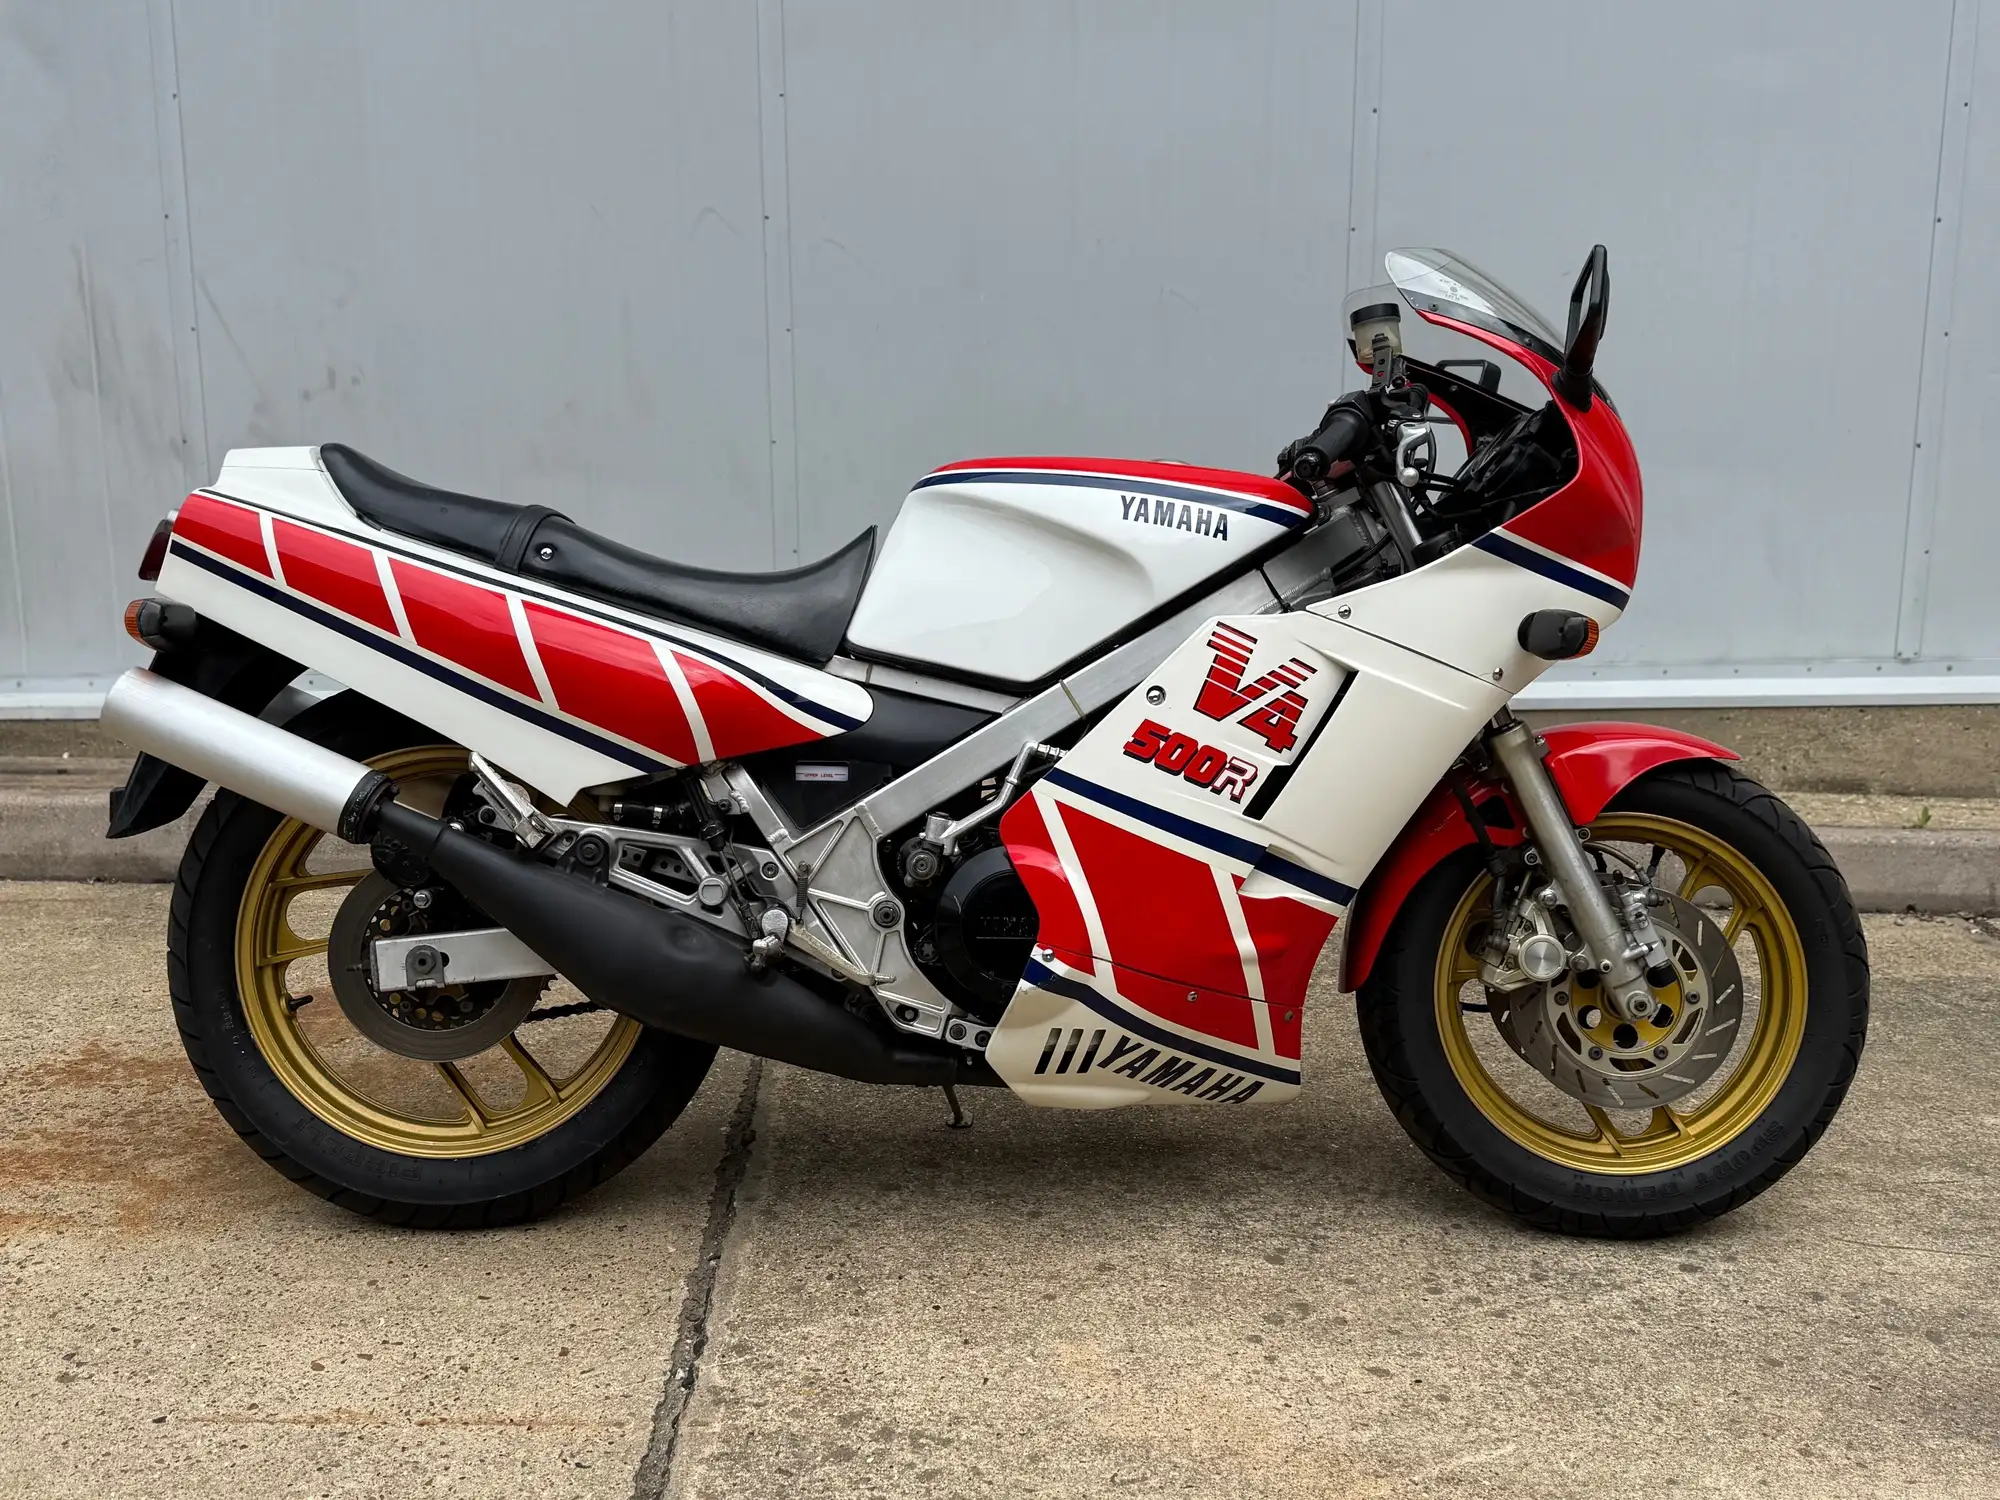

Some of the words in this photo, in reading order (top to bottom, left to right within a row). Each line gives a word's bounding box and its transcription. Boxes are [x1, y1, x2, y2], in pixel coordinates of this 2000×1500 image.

[1121, 495, 1228, 541] YAMAHA
[1193, 621, 1318, 753] V4
[1123, 718, 1258, 804] 500R
[1097, 1035, 1265, 1104] YAMAHA
[295, 1117, 422, 1181] PIRELLI
[1695, 1121, 1784, 1188] SPORT
[1572, 1182, 1684, 1203] DEMON
